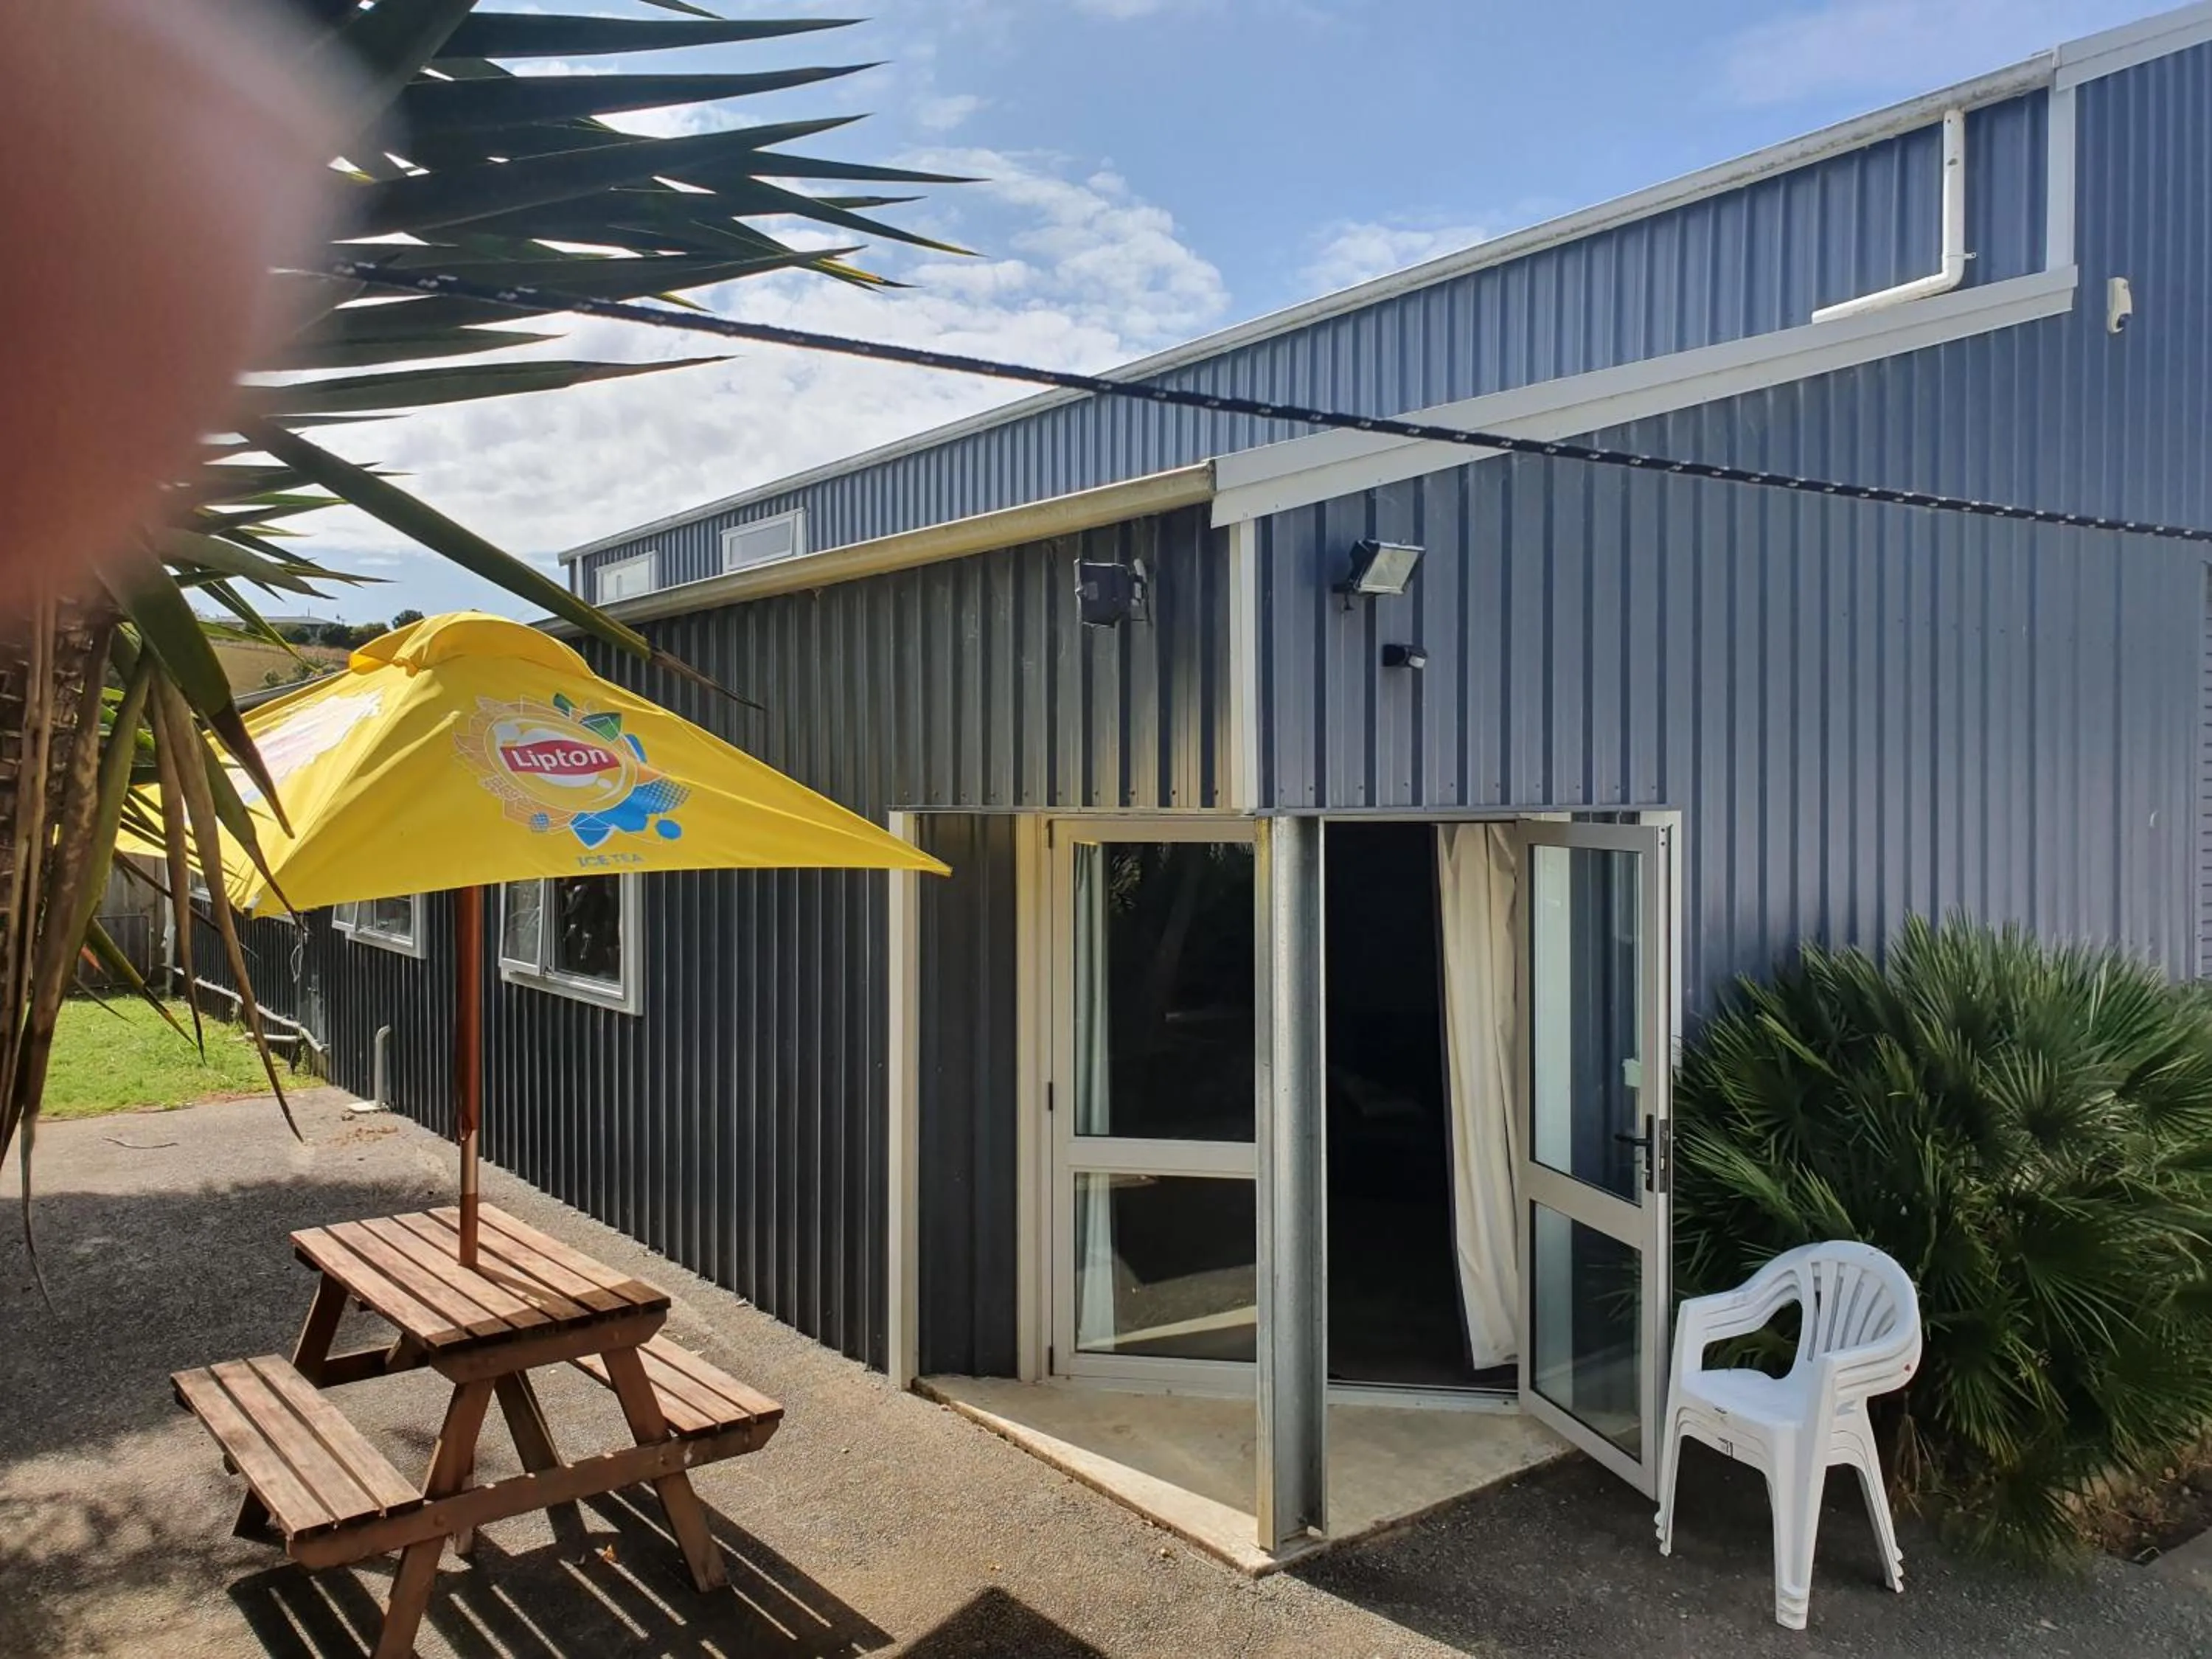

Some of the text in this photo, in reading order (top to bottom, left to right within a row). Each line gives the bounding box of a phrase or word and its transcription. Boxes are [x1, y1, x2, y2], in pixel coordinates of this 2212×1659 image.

[511, 748, 609, 771] Lipton
[577, 853, 645, 868] ICE TEA
